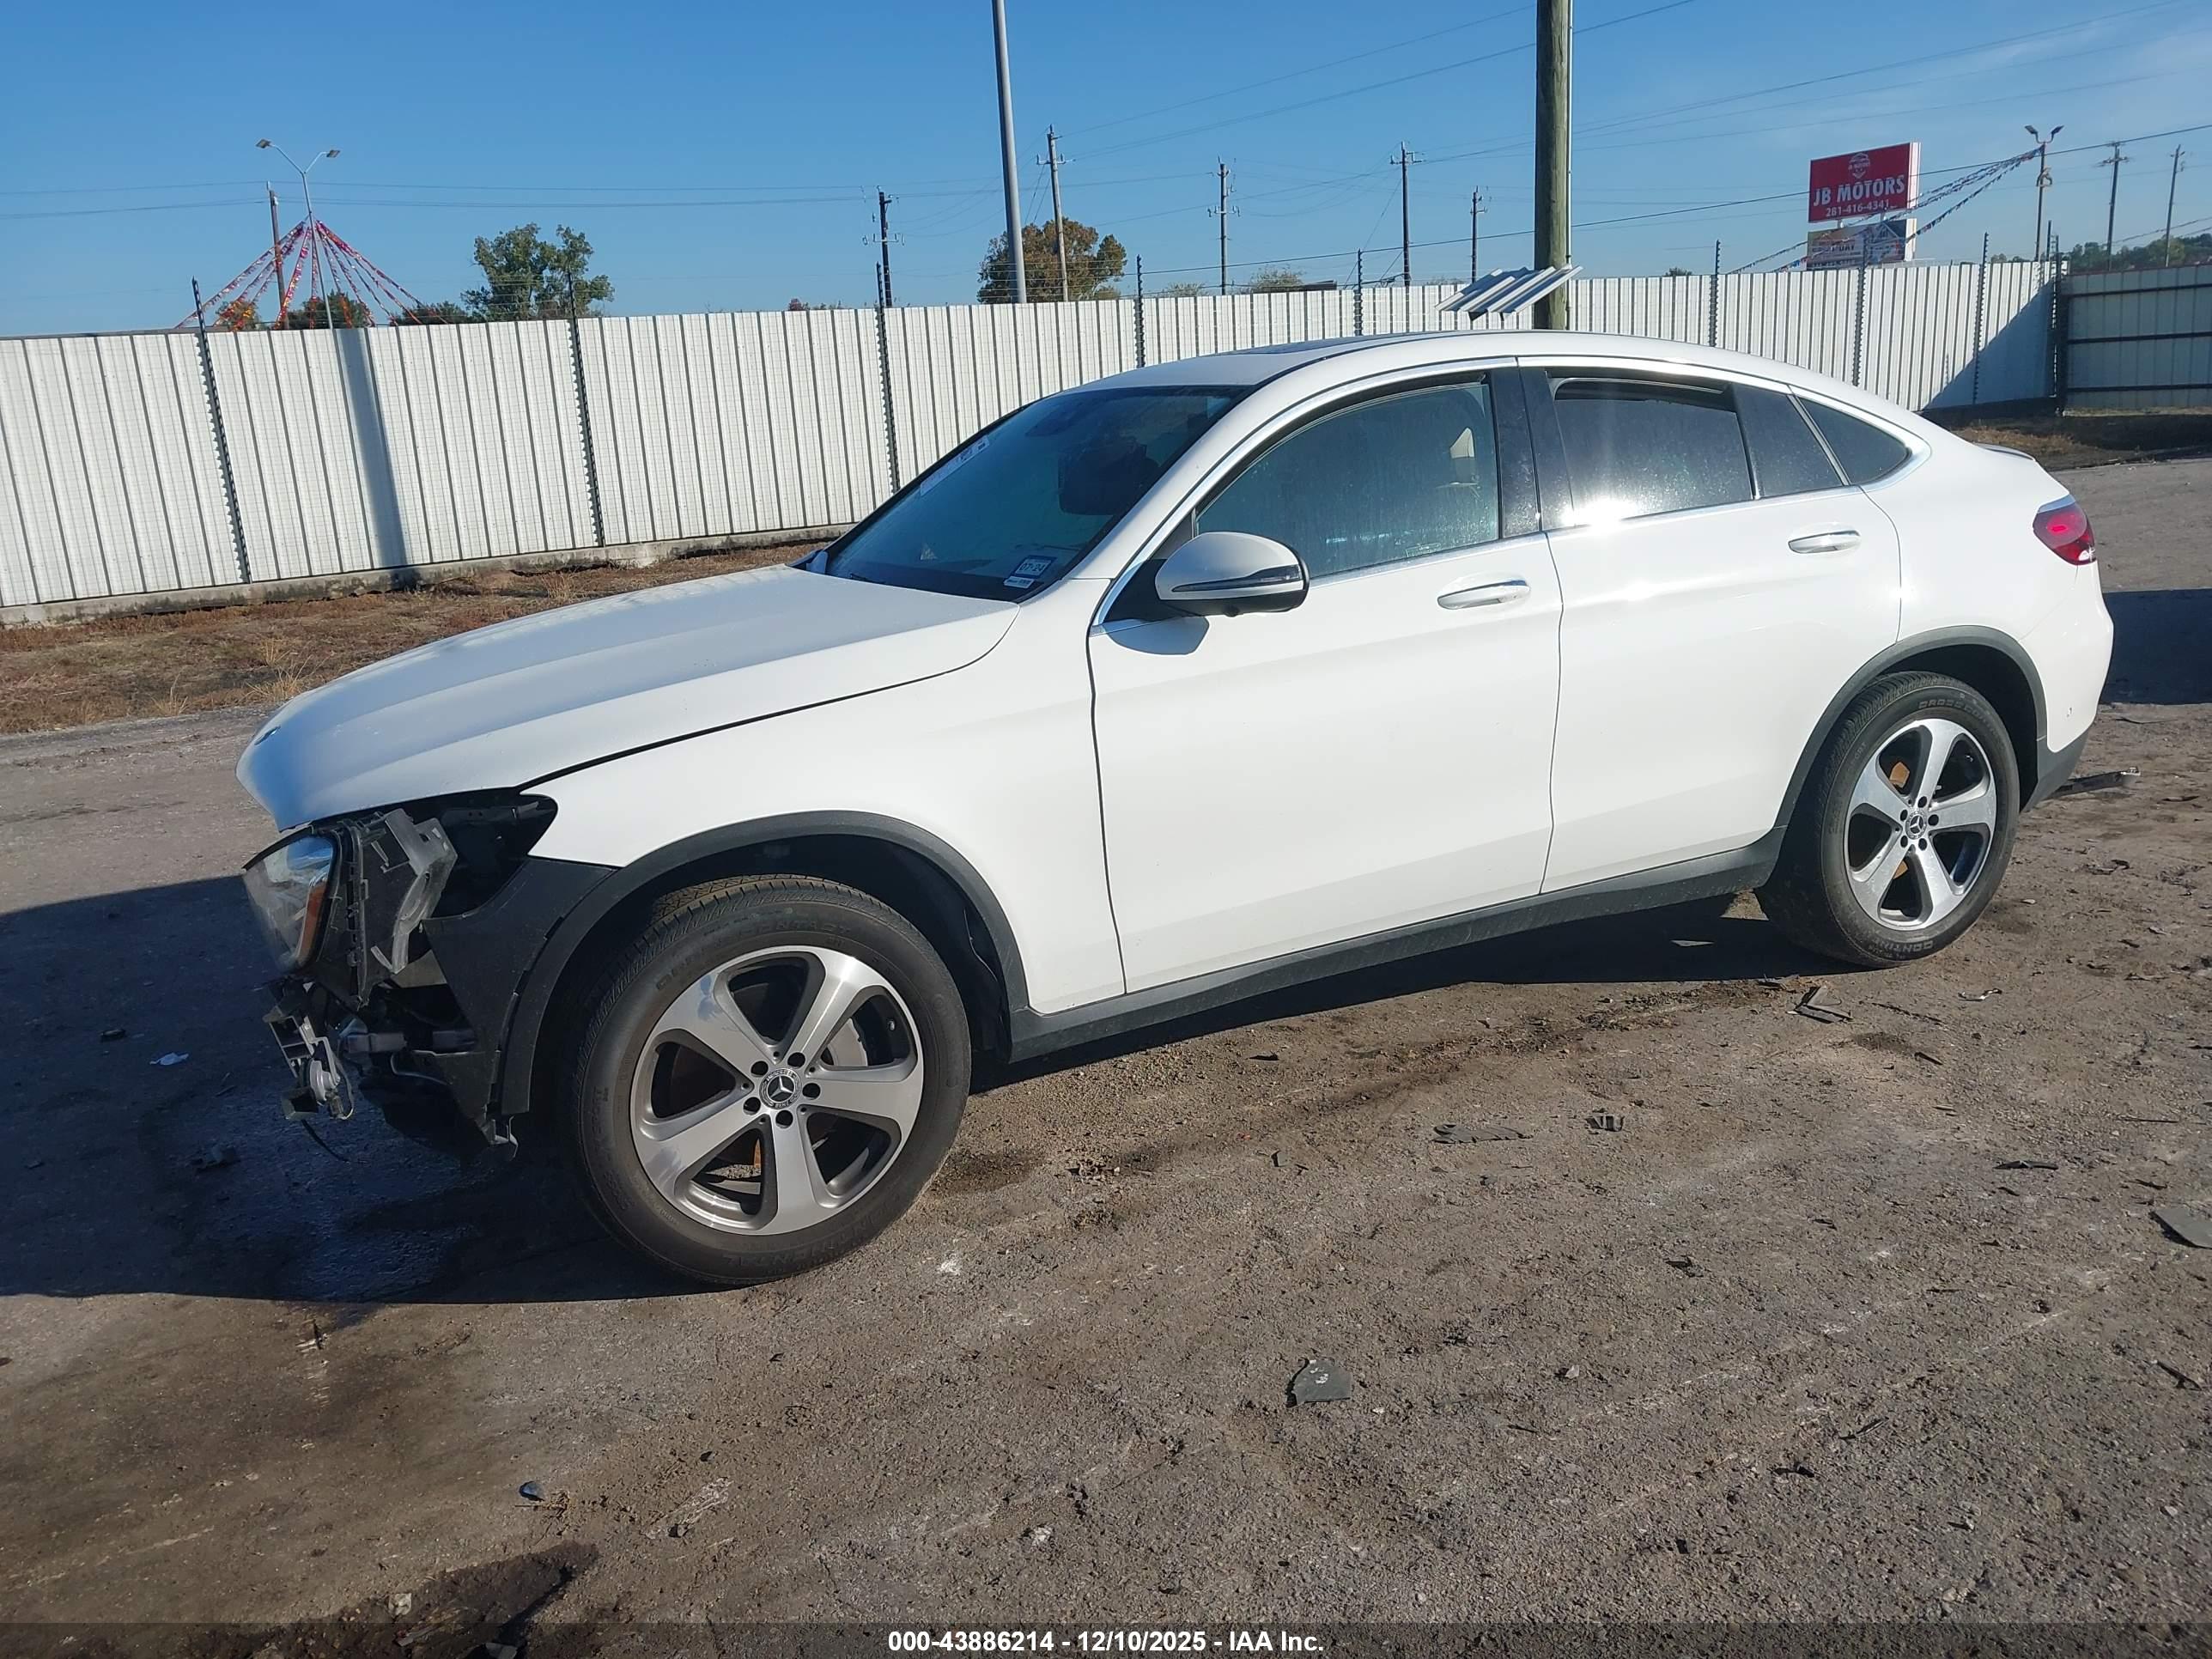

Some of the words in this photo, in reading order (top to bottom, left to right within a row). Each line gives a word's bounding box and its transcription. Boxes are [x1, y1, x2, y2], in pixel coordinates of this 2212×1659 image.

[1813, 187, 1832, 206] JB
[1837, 175, 1905, 202] MOTORS
[1826, 199, 1890, 217] 281-416-4341
